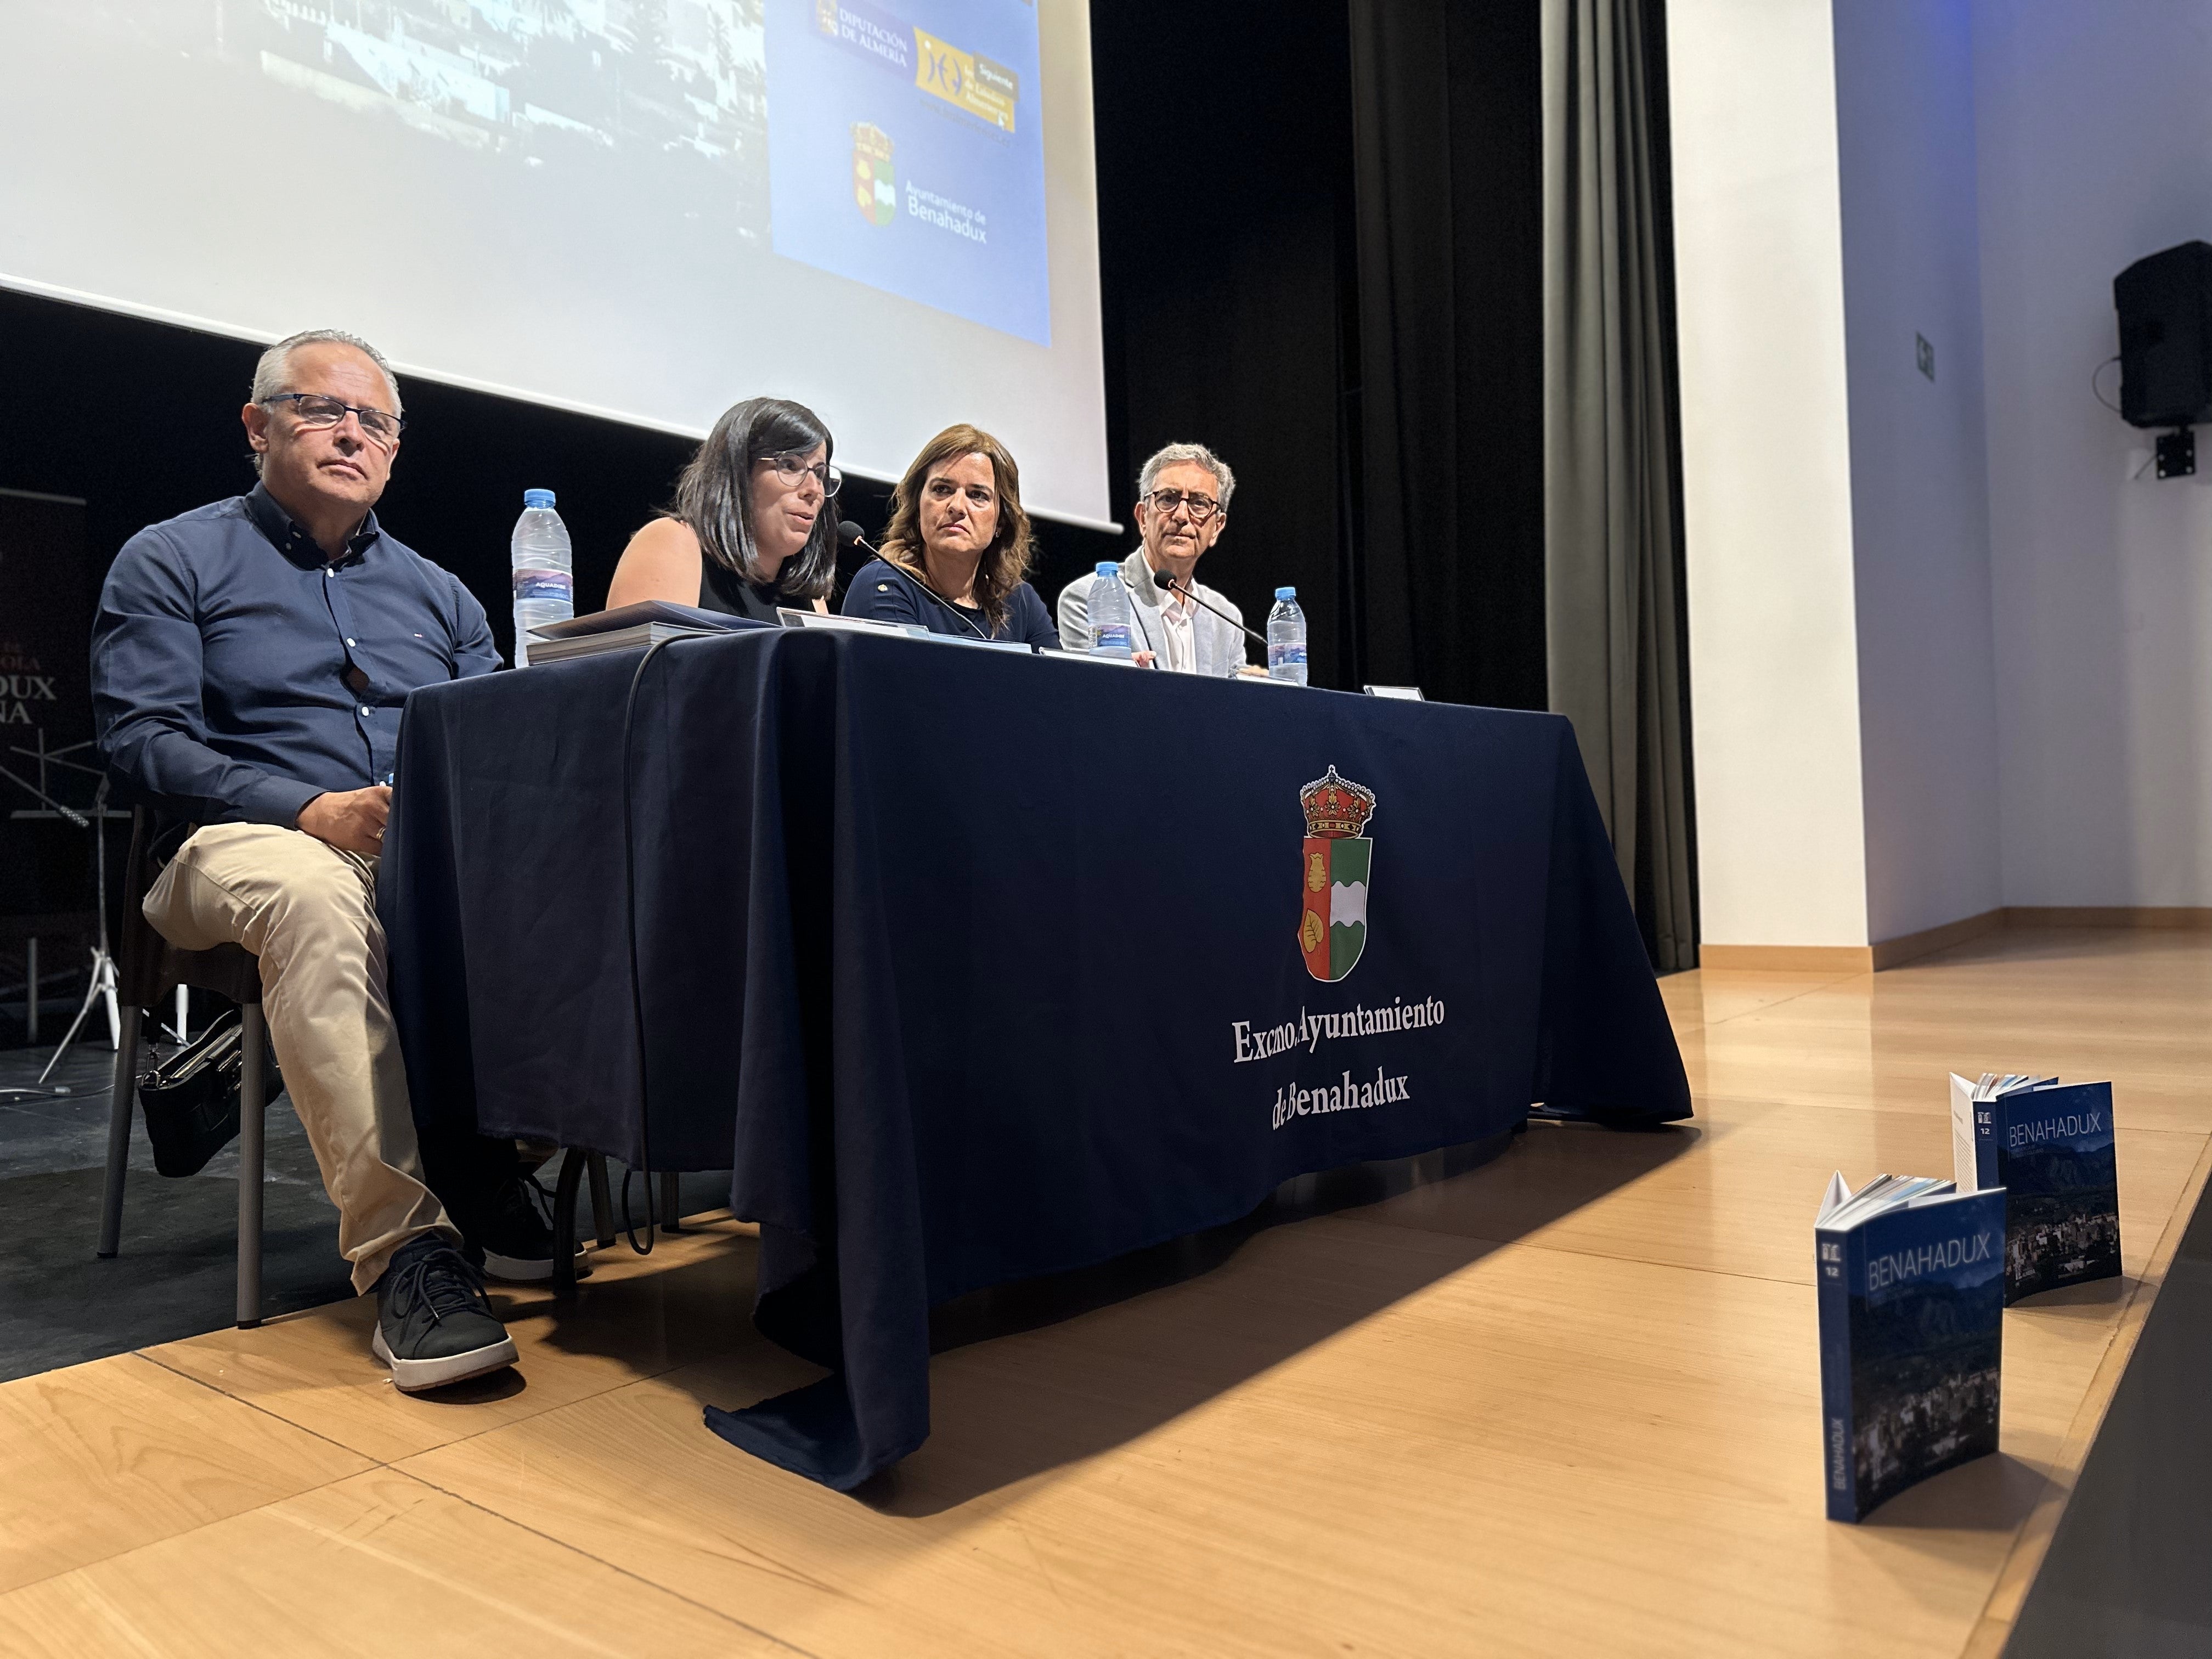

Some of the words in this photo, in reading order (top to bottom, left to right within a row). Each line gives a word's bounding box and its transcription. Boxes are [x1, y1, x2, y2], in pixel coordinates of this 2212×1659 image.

[842, 24, 856, 43] DE
[906, 179, 973, 220] Ayuntamiento
[974, 210, 986, 225] de
[908, 194, 987, 244] Benahadux
[1296, 996, 1444, 1053] Ayuntamiento
[1272, 1087, 1287, 1130] de
[1286, 1065, 1410, 1121] Benahadux
[2009, 1112, 2102, 1147] BENAHADUX
[1825, 1266, 1839, 1277] 12
[1869, 1232, 1990, 1291] BENAHADUX
[1831, 1418, 1847, 1491] BENAHADUX
